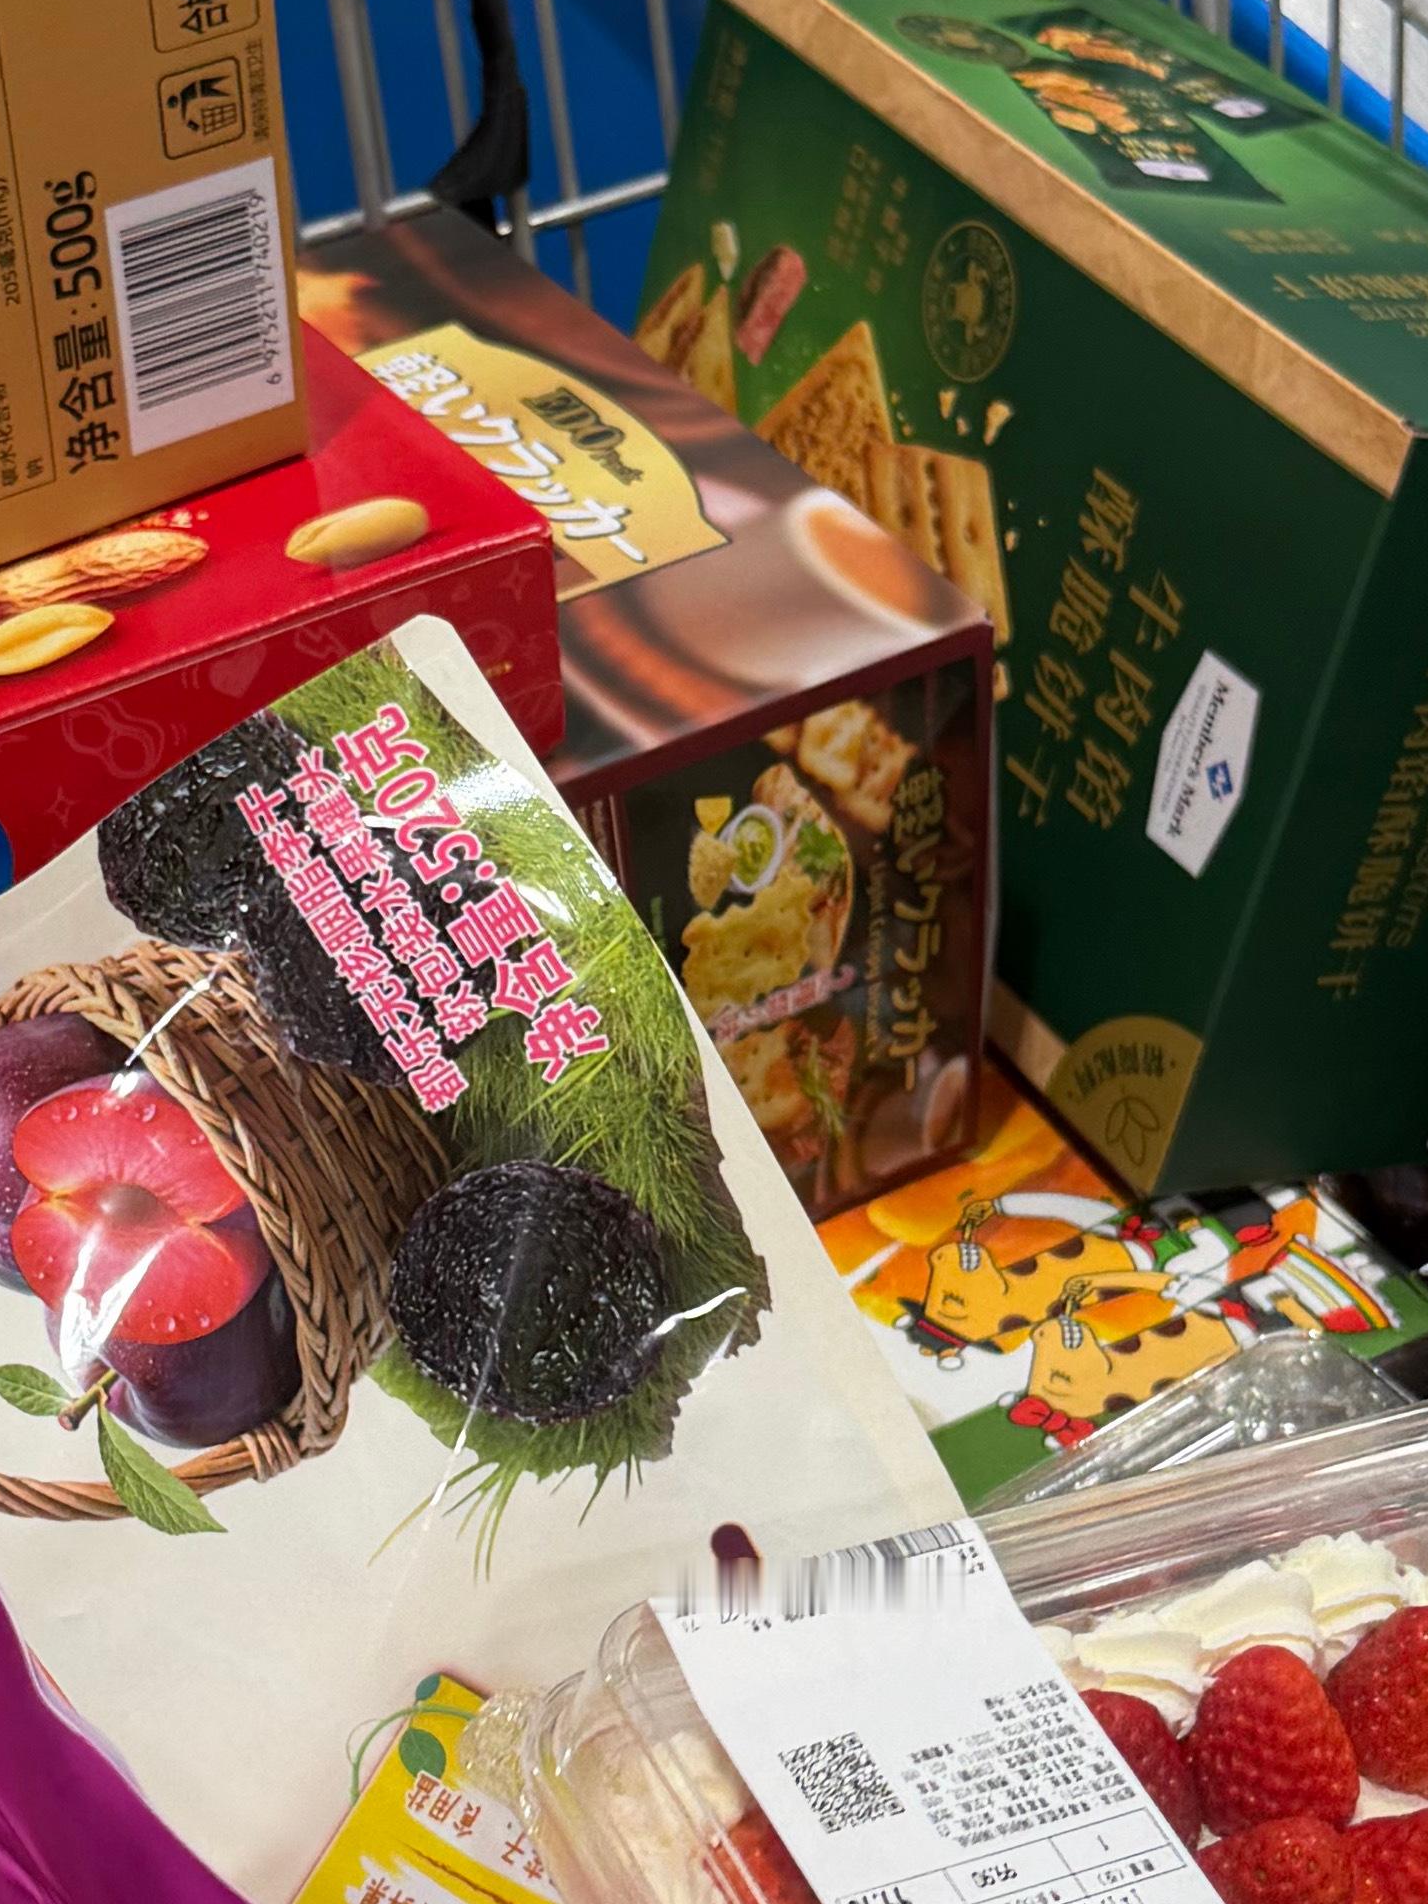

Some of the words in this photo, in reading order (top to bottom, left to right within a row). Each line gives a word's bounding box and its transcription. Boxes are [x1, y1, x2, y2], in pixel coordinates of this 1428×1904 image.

[994, 459, 1145, 840] 酥脆饼干
[1062, 550, 1191, 844] 牛肉馅
[1181, 673, 1234, 790] Member's
[236, 783, 469, 1114] 都乐无核胭脂李干
[288, 746, 489, 1044] 软包装水果罐头
[333, 703, 611, 1084] 净含量:520克
[1161, 775, 1199, 848] Mark
